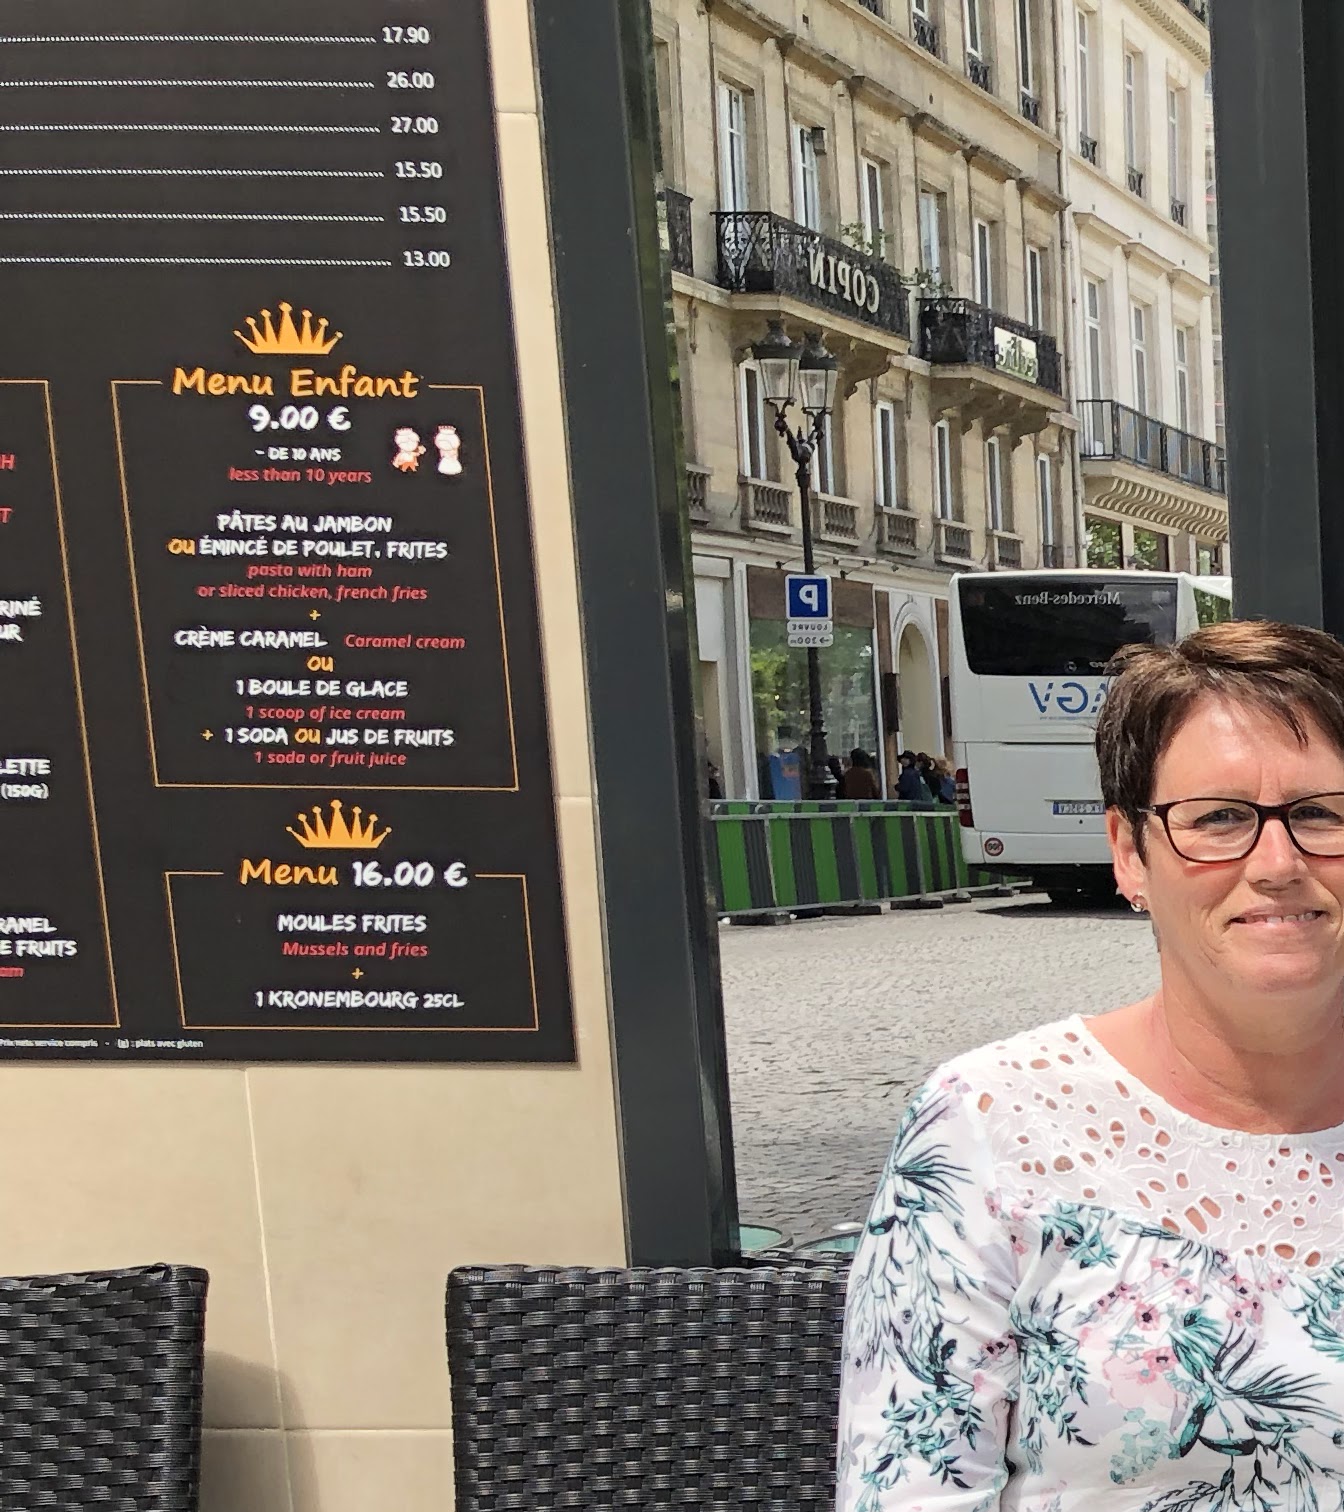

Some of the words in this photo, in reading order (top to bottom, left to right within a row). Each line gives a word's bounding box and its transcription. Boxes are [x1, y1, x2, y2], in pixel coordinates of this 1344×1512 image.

[382, 27, 430, 44] 17.90
[386, 72, 434, 89] 26.00
[391, 117, 438, 134] 27.00
[395, 162, 442, 179] 15.50
[399, 207, 446, 223] 15.50
[403, 251, 450, 268] 13.00
[172, 366, 273, 396] Menu
[290, 365, 420, 398] Enfant
[248, 404, 319, 432] 9.00
[327, 405, 351, 431] €
[310, 448, 341, 462] ANS
[229, 466, 259, 482] less
[263, 467, 300, 482] than
[328, 469, 372, 485] years
[217, 508, 277, 532] PÂTES
[281, 515, 308, 533] AU
[313, 516, 393, 534] JAMBON
[167, 538, 195, 556] OU
[199, 535, 268, 556] ÉMINCÉ
[272, 539, 298, 556] DE
[302, 539, 380, 559] POULET,
[387, 541, 448, 560] FRITES
[247, 564, 293, 580] pasta
[298, 563, 331, 578] with
[337, 564, 372, 579] ham
[219, 584, 264, 599] sliced
[268, 584, 332, 601] chicken,
[336, 584, 387, 602] french
[392, 585, 427, 602] fries
[174, 625, 235, 648] CRÈME
[239, 631, 328, 649] CARAMEL
[344, 634, 412, 649] Caramel
[415, 637, 465, 650] cream
[307, 655, 334, 672] OU
[248, 680, 311, 697] BOULE
[316, 681, 341, 696] DE
[346, 681, 408, 698] GLACE
[259, 708, 304, 722] scoop
[329, 705, 351, 720] ice
[356, 708, 405, 721] cream
[237, 728, 288, 745] SODA
[294, 728, 320, 744] OU
[325, 728, 359, 745] JUS
[363, 729, 390, 744] DE
[394, 728, 455, 747] FRUITS
[267, 751, 304, 764] soda
[330, 751, 365, 768] fruit
[368, 752, 406, 768] juice
[240, 858, 339, 886] Menu
[353, 861, 434, 887] 16.00
[444, 862, 468, 887] €
[277, 914, 356, 932] MOULES
[362, 914, 427, 934] FRITES
[15, 940, 78, 957] FRUITS
[282, 941, 349, 957] Mussels
[353, 942, 386, 957] and
[389, 942, 428, 961] fries
[268, 990, 419, 1010] KRONEMBOURG
[423, 992, 465, 1009] 25CL
